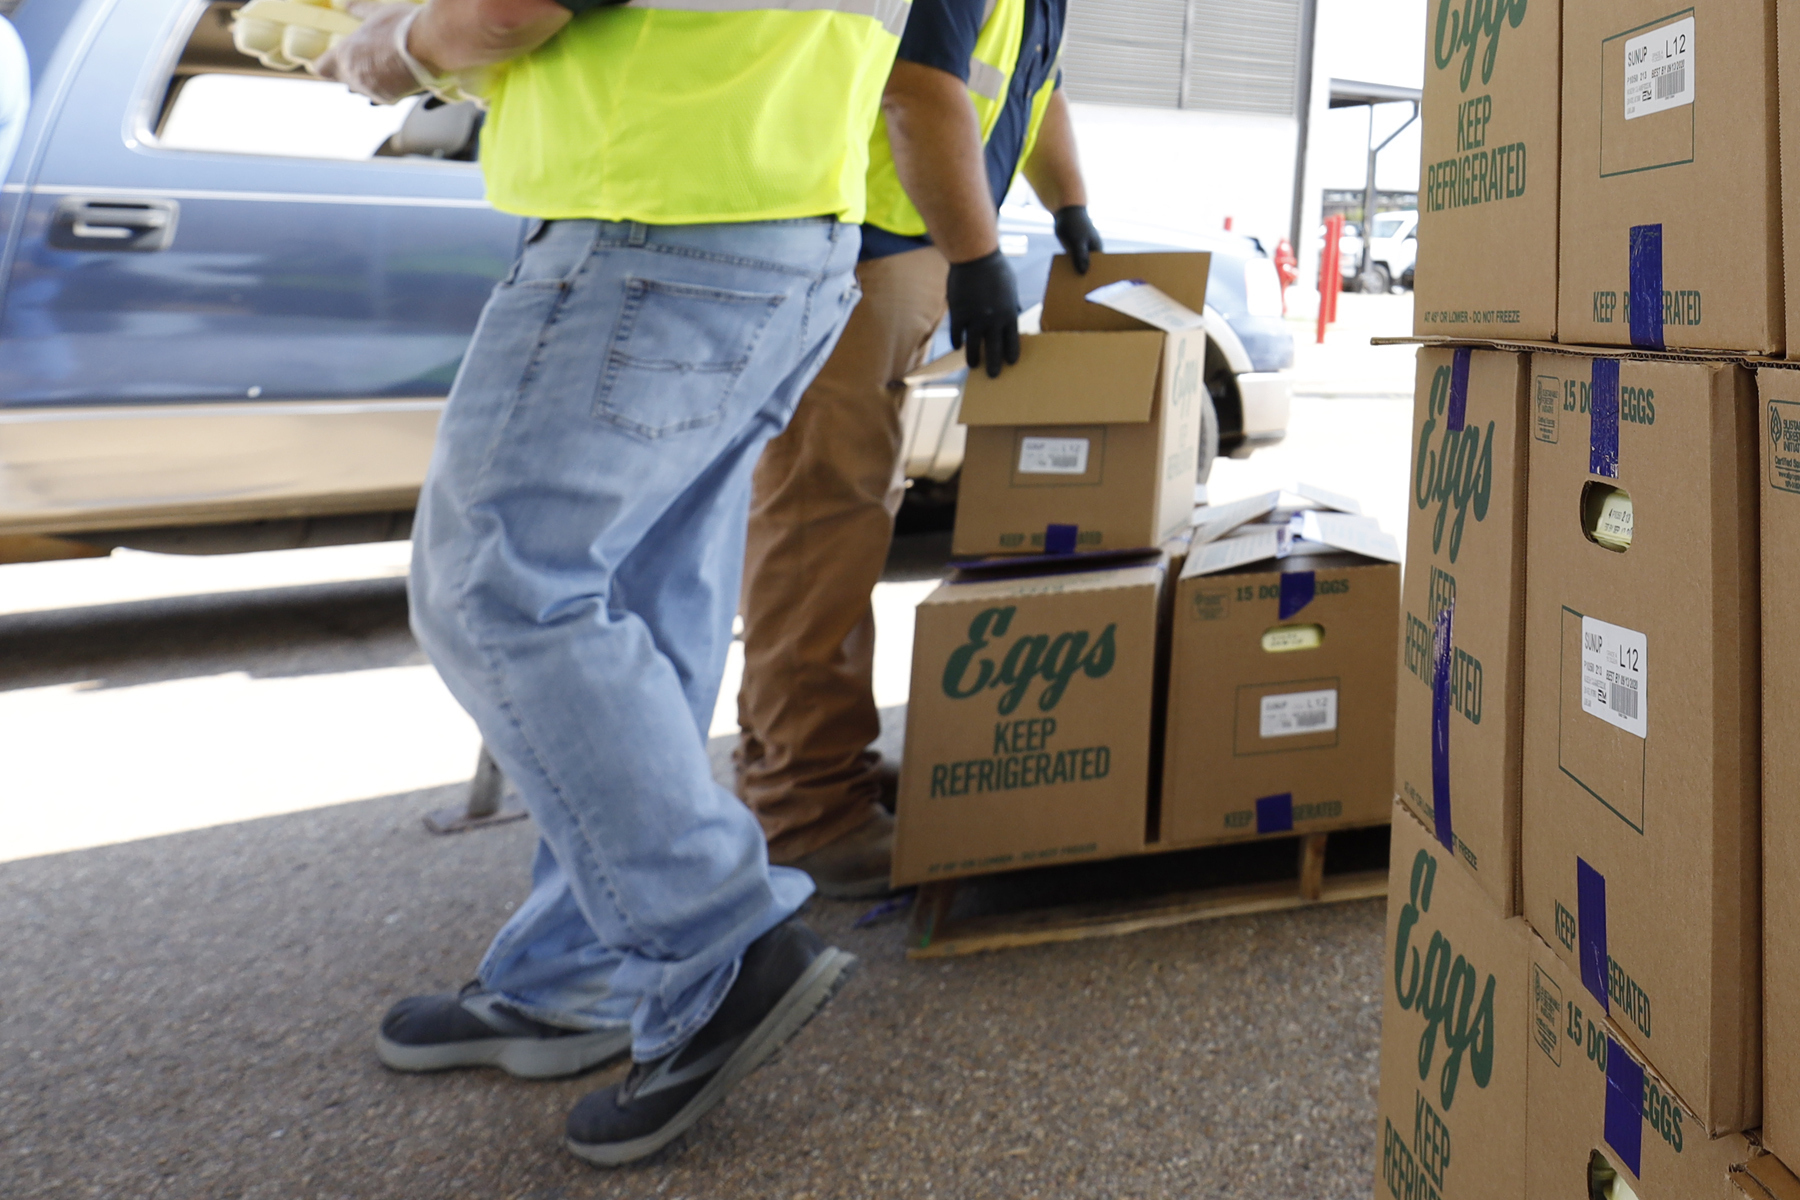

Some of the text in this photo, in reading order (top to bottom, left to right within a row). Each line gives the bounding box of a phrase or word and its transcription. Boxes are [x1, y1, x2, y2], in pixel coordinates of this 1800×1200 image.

[1627, 46, 1648, 67] SUNUP
[1457, 94, 1492, 153] KEEP
[1426, 141, 1527, 213] REFRIGERATED
[1440, 311, 1448, 323] OR
[1448, 311, 1469, 323] LOWER
[1472, 311, 1481, 323] DO
[1482, 310, 1495, 323] NOT
[1496, 310, 1520, 324] FREEZE
[1593, 290, 1702, 326] KEEP RERATED
[1563, 379, 1577, 412] 15
[1621, 385, 1656, 426] EGGS
[1416, 365, 1495, 564] Eggs
[1236, 585, 1253, 602] 15
[1428, 564, 1457, 626] KEEP
[940, 604, 1117, 716] Eggs
[993, 718, 1057, 756] KEEP
[930, 745, 1111, 799] REFRIGERATED
[1554, 899, 1576, 953] KEEP
[1394, 848, 1497, 1113] Eggs
[1567, 1000, 1683, 1154] 15 EGGS
[1413, 1088, 1451, 1193] KEEP
